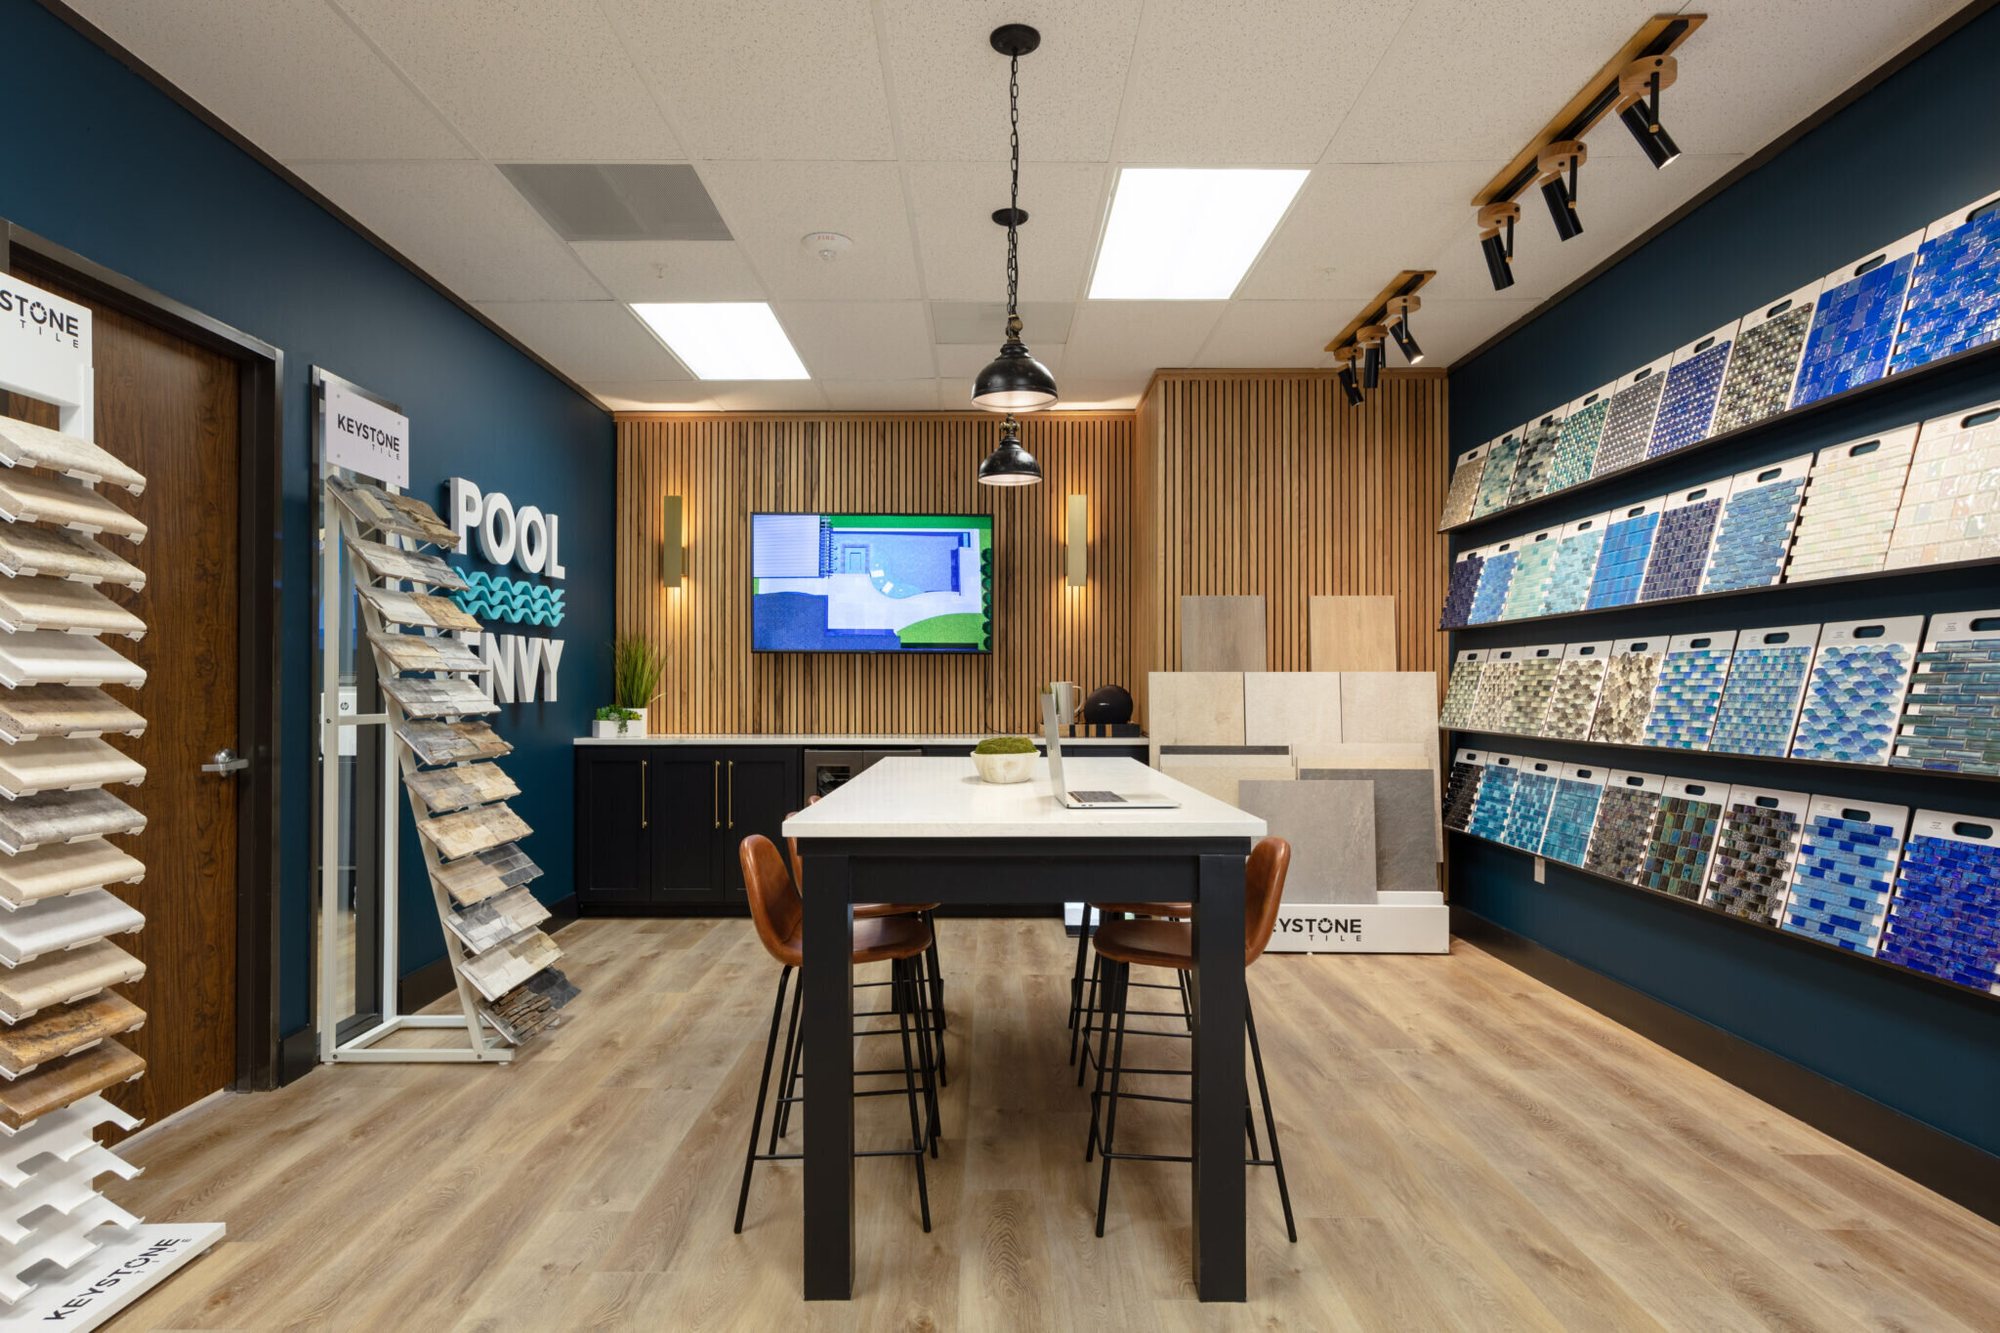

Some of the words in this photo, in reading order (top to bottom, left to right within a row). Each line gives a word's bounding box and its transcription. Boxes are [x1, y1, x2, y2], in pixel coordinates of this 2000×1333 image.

[20, 319, 79, 349] TILE
[337, 413, 400, 452] KEYSTONE
[372, 443, 400, 461] TILE
[450, 477, 566, 580] POOL
[1273, 918, 1362, 934] YSTONE
[43, 1238, 180, 1321] KEYSTONE
